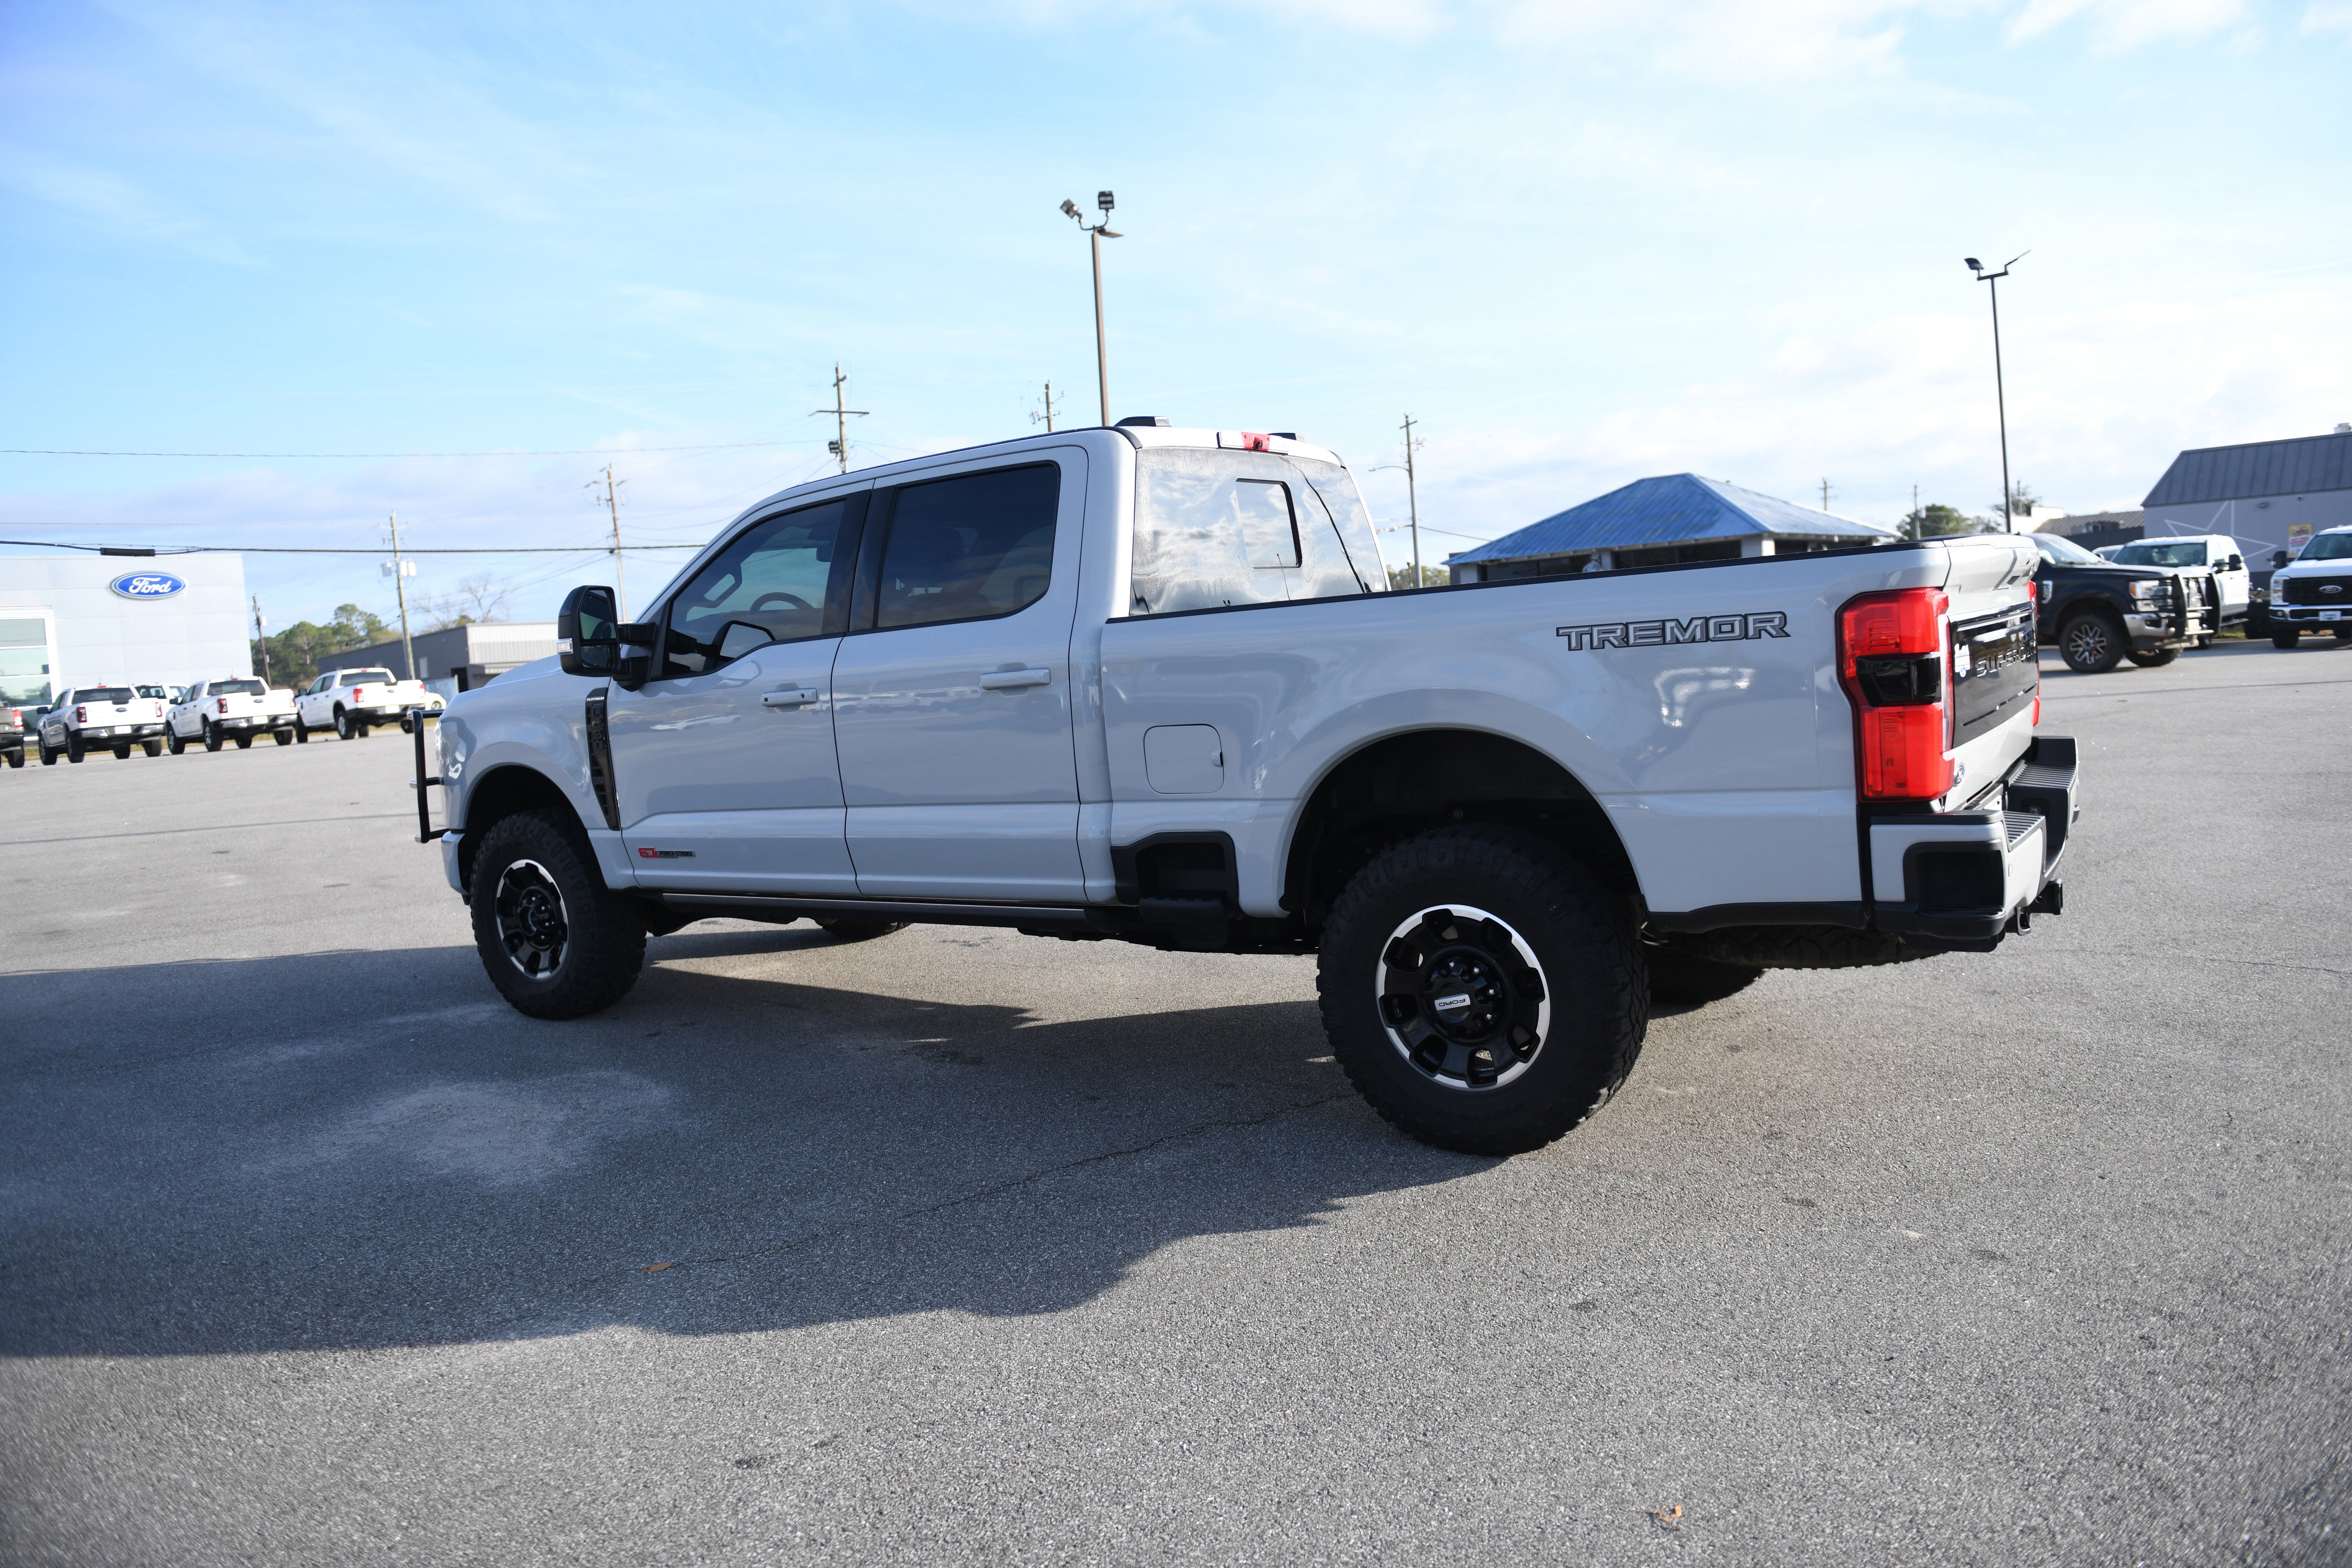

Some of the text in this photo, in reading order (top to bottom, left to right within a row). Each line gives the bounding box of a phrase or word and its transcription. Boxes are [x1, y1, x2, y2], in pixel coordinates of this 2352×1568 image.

[129, 577, 172, 593] Ford
[1556, 611, 1791, 651] TREMOR
[1439, 998, 1466, 1007] FORD
